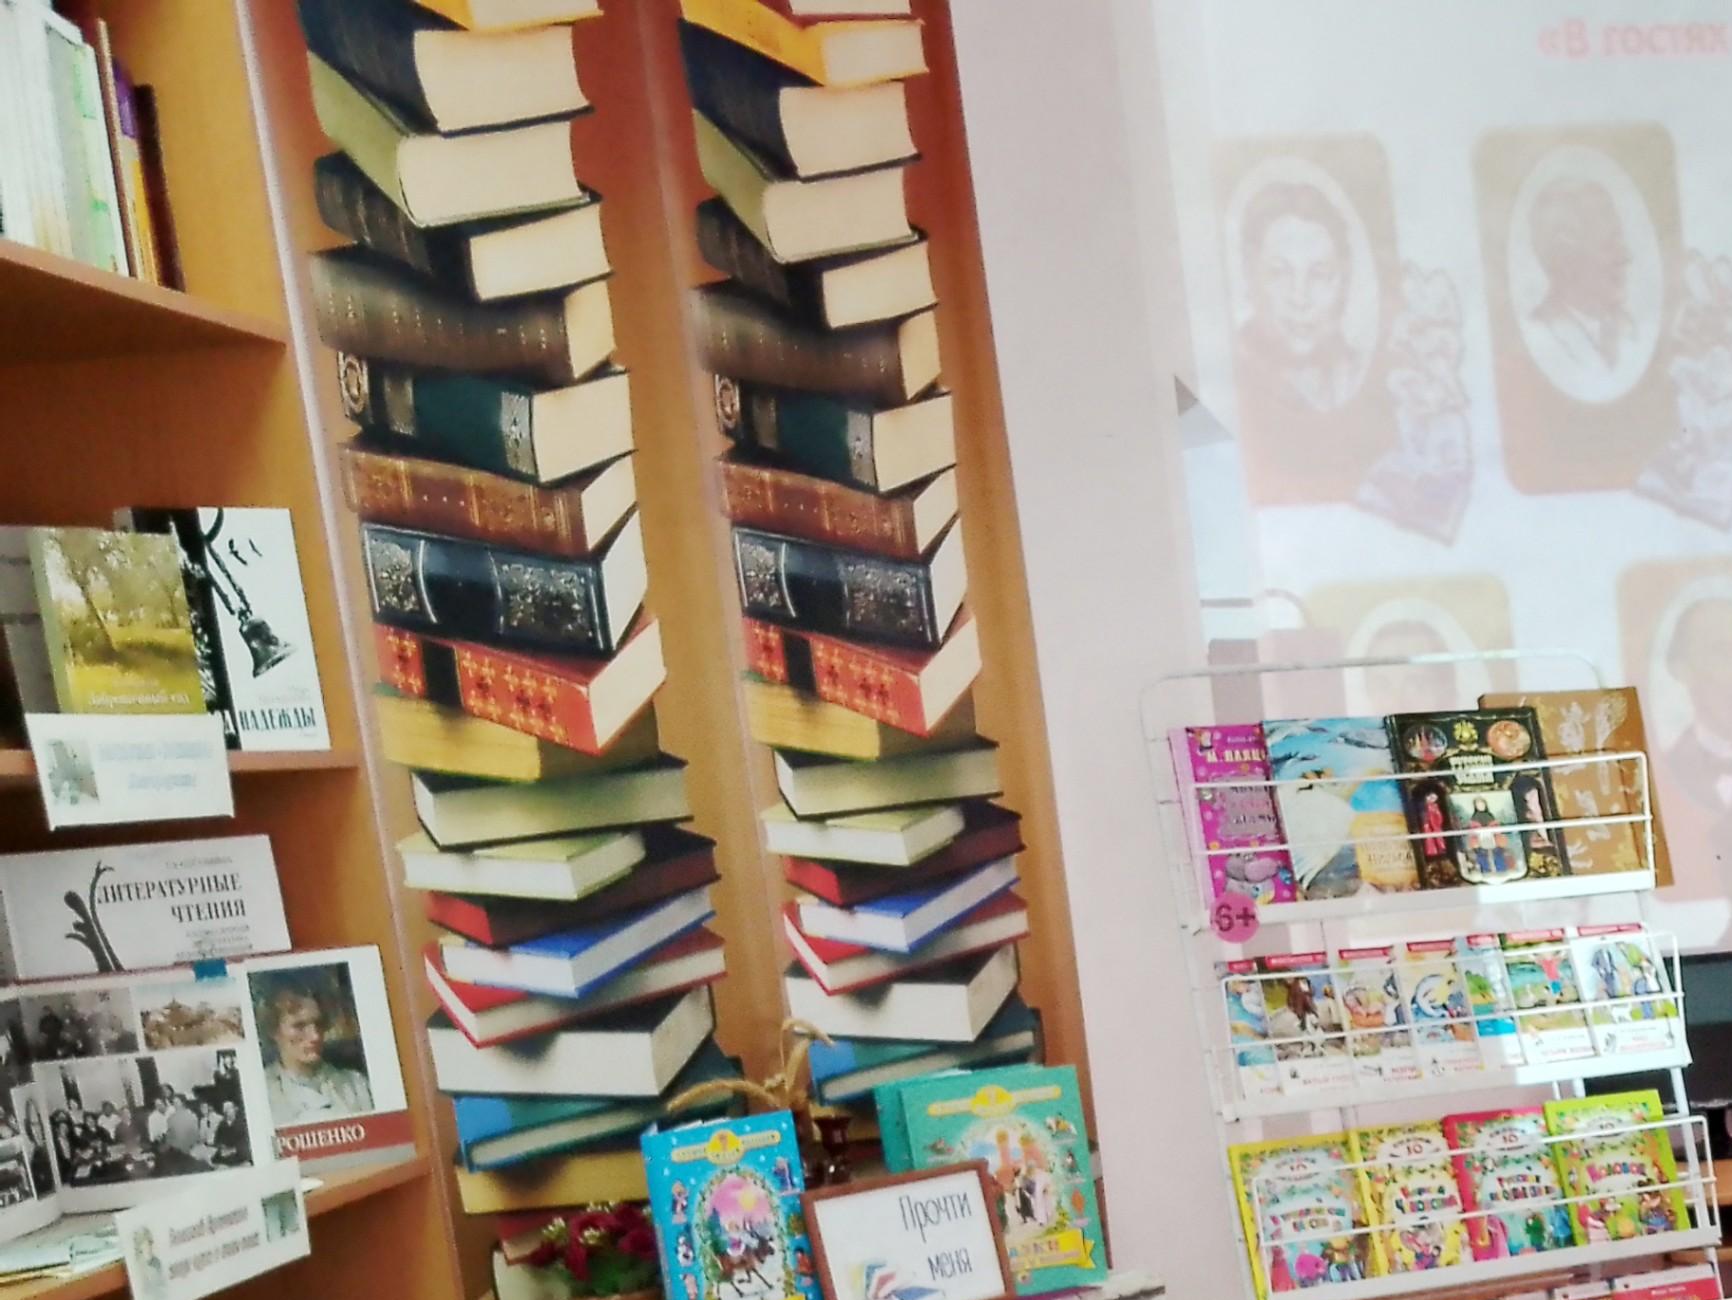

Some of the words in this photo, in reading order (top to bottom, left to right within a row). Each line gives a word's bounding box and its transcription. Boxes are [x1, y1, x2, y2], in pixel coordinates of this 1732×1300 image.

[1602, 20, 1728, 57] гостях
[97, 872, 242, 904] ЛИТЕРАТУРНЫЕ
[171, 899, 247, 923] ЧТЕНИЯ
[1215, 903, 1256, 932] 6+
[899, 1191, 972, 1244] Прочти
[927, 1247, 973, 1281] меня
